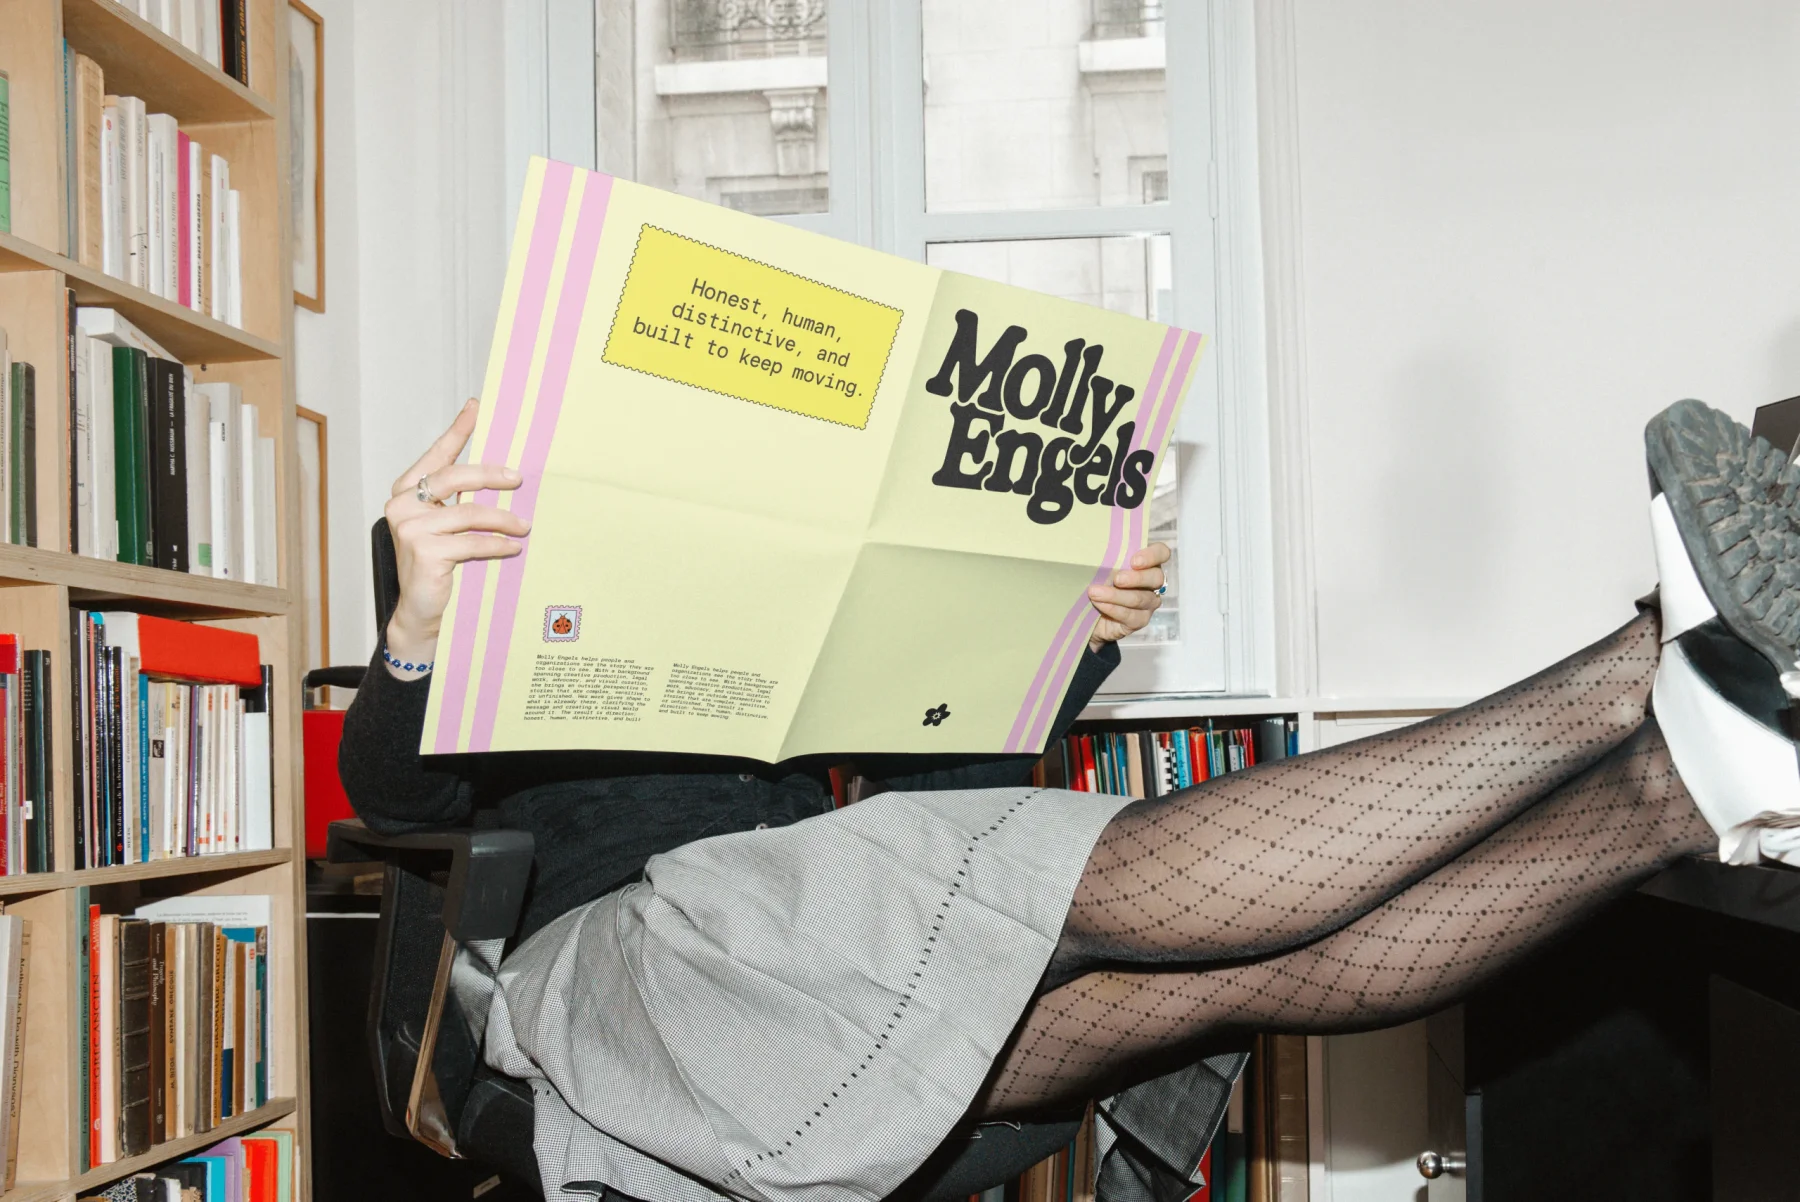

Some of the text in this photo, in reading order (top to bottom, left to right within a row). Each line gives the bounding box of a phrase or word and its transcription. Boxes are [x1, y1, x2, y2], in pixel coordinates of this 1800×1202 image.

[671, 302, 851, 368] distinctive, and
[692, 277, 841, 344] Honest, human,
[632, 316, 863, 398] built to keep moving.
[926, 309, 1135, 465] Molly
[932, 402, 1155, 525] Engels
[151, 973, 159, 1006] Philosophy
